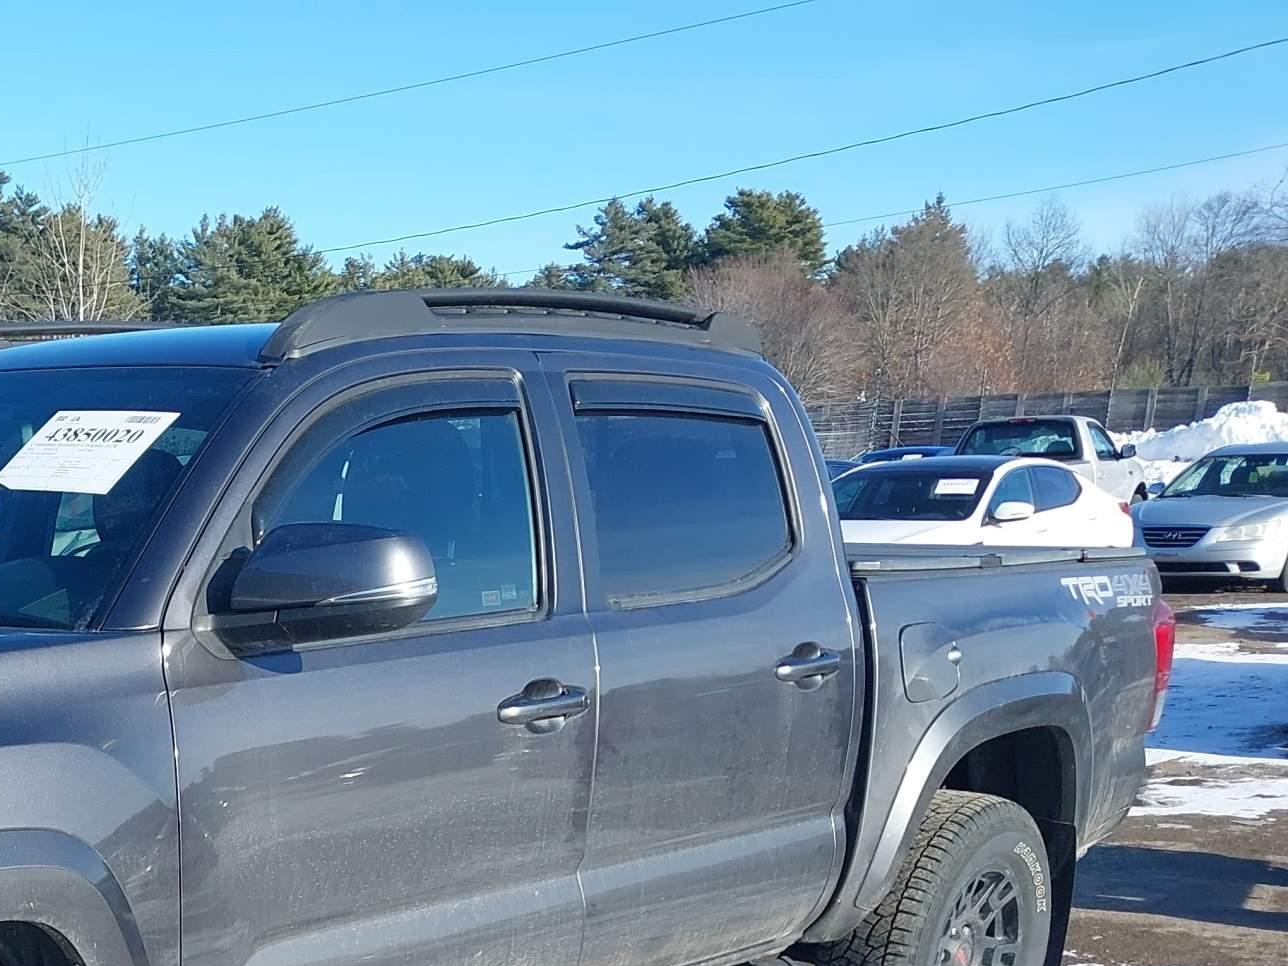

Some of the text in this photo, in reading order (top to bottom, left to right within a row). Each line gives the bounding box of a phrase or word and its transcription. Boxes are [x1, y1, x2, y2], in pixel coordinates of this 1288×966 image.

[44, 427, 145, 444] 43850020
[1060, 575, 1113, 605] TRD
[1116, 595, 1154, 608] SPORT
